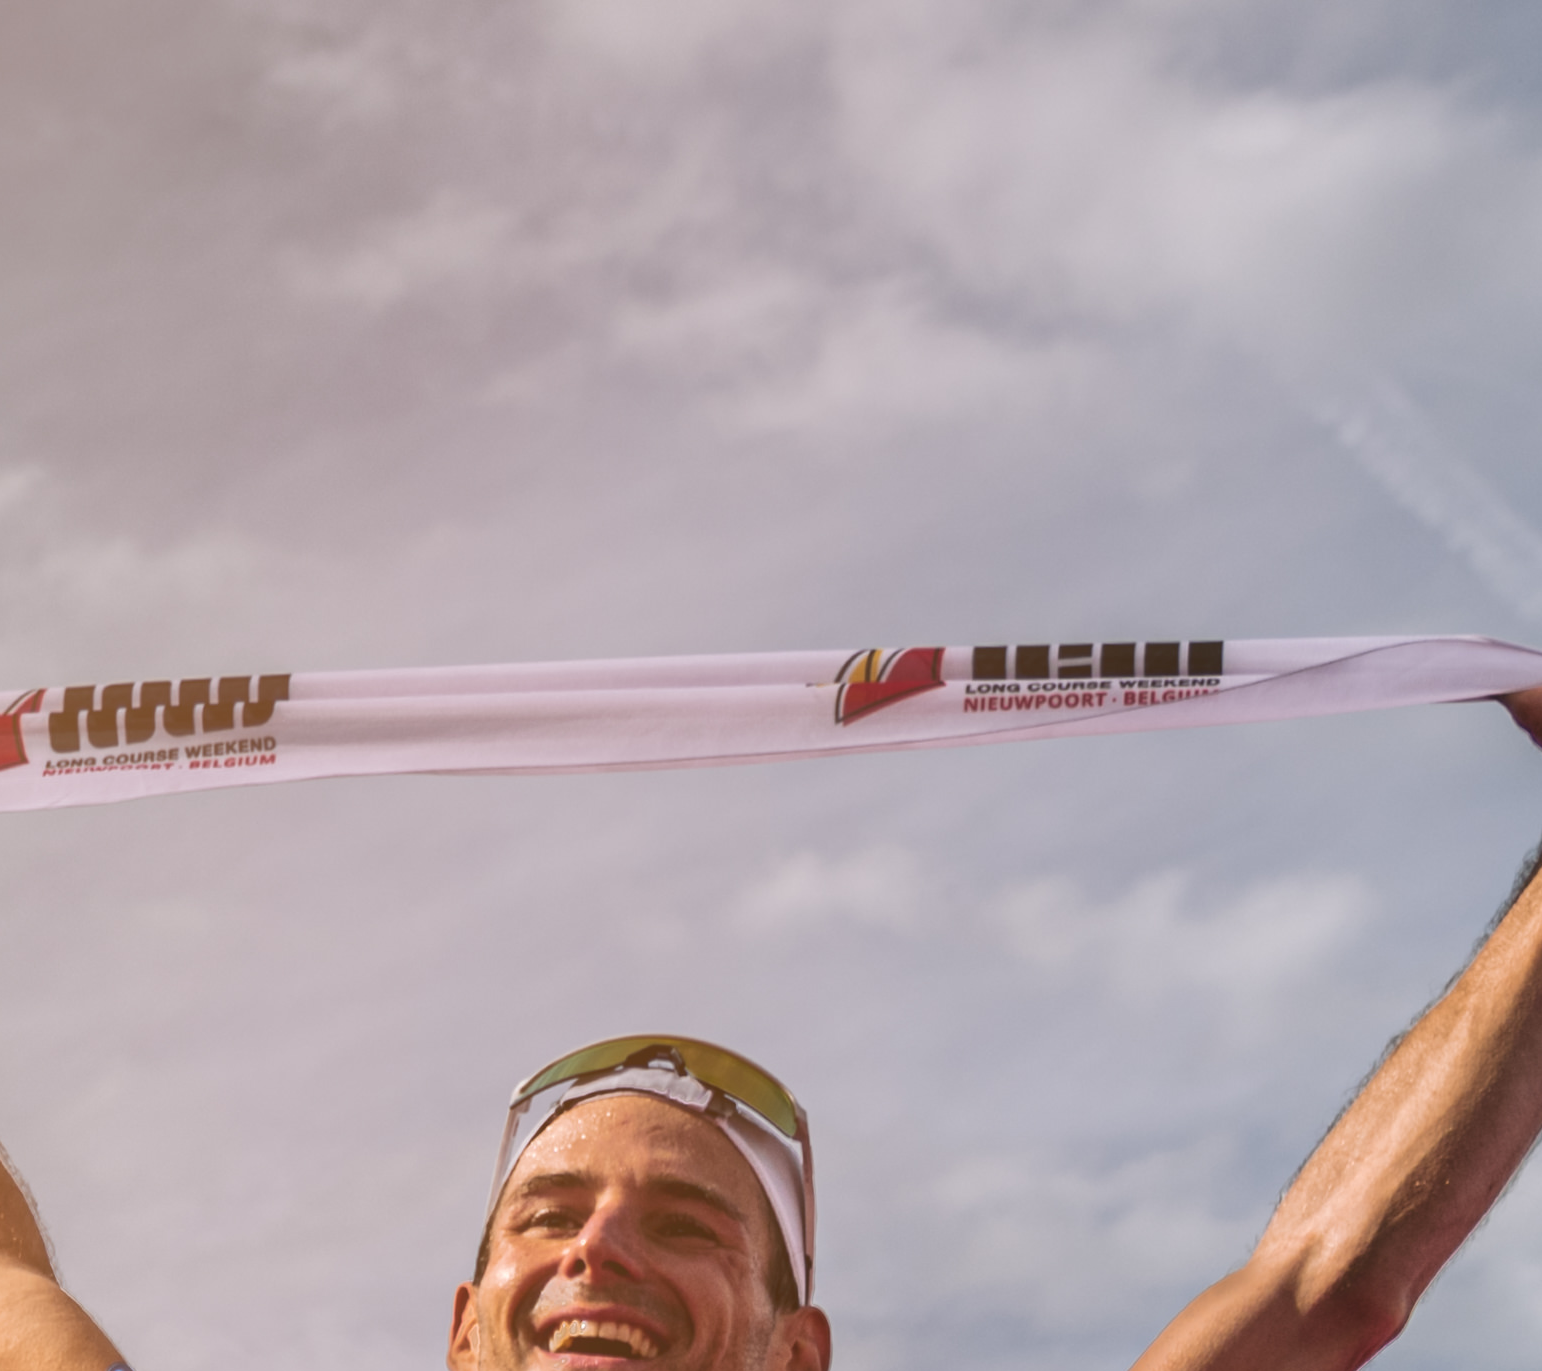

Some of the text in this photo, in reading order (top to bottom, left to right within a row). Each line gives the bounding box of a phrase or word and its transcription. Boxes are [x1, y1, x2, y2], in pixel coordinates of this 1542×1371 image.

[965, 678, 1220, 695] LONG COURSE WEEKEND
[963, 691, 1107, 713] NIEUWPOORT
[46, 736, 277, 770] LONG COURSE WEEKEND
[189, 753, 277, 770] BELGIUM
